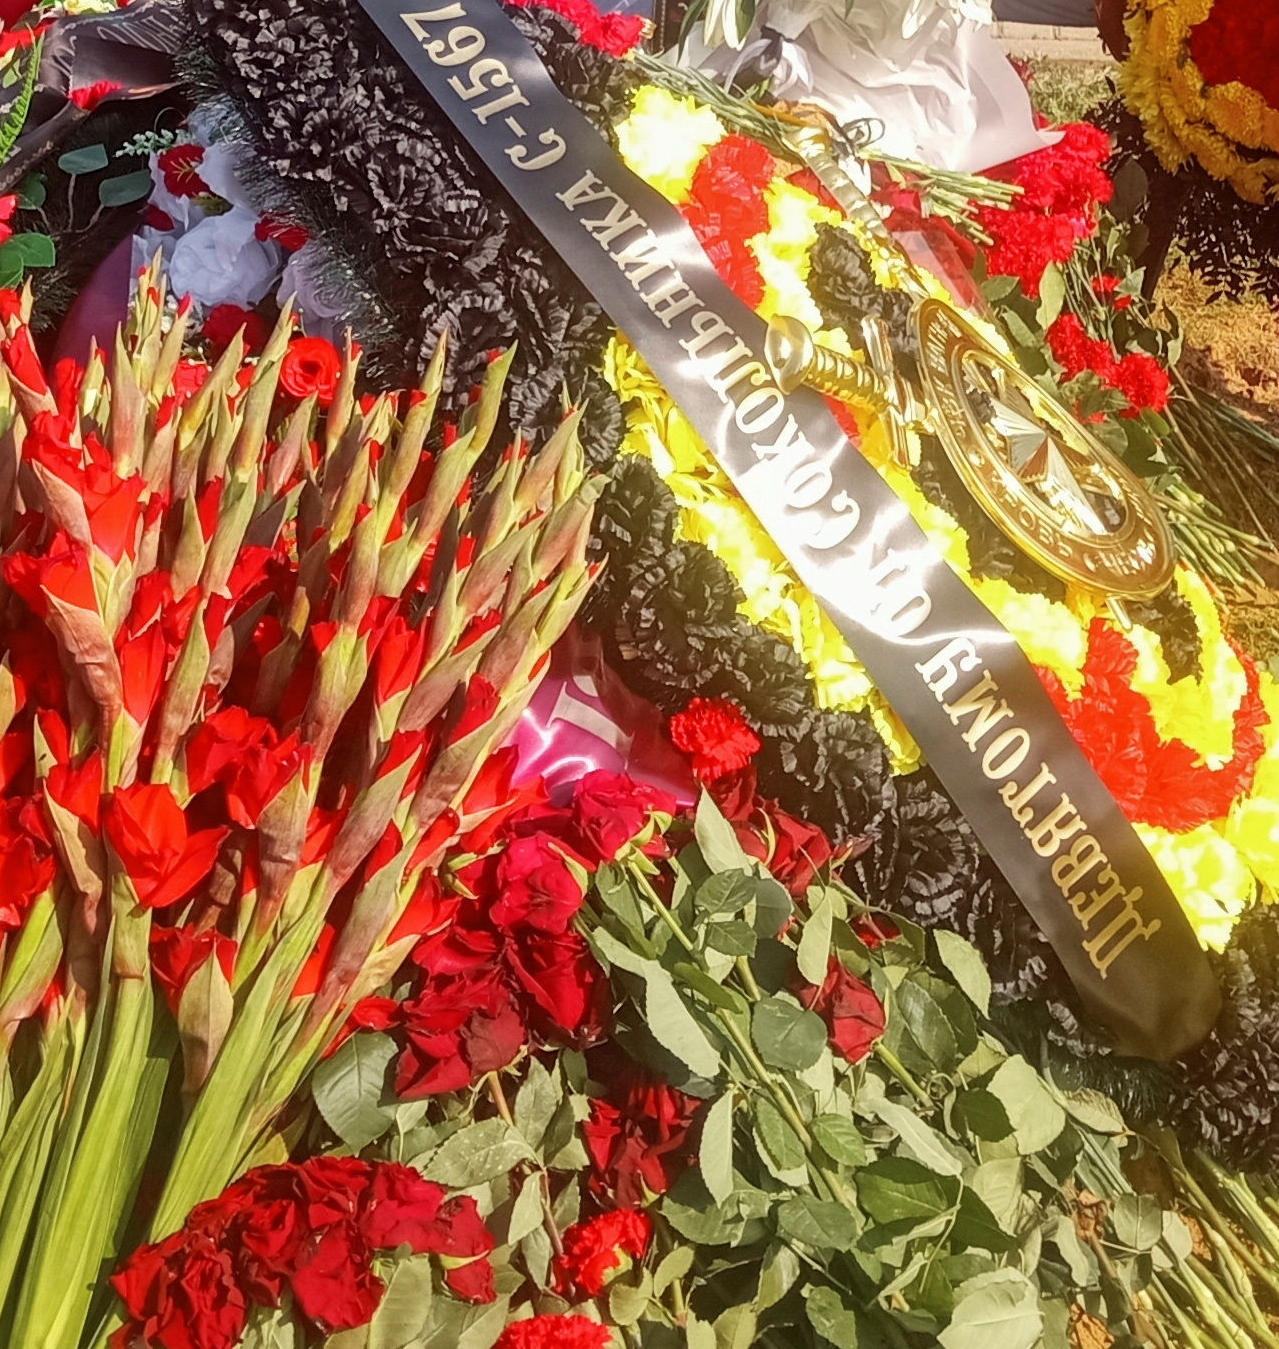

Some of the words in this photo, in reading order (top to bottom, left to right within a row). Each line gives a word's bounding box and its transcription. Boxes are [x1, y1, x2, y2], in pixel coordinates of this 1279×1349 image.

[398, 0, 568, 173] С-1567
[554, 167, 862, 554] СОКОЛЬНИКА
[914, 634, 1164, 979] ДЕВЯТОМУ
